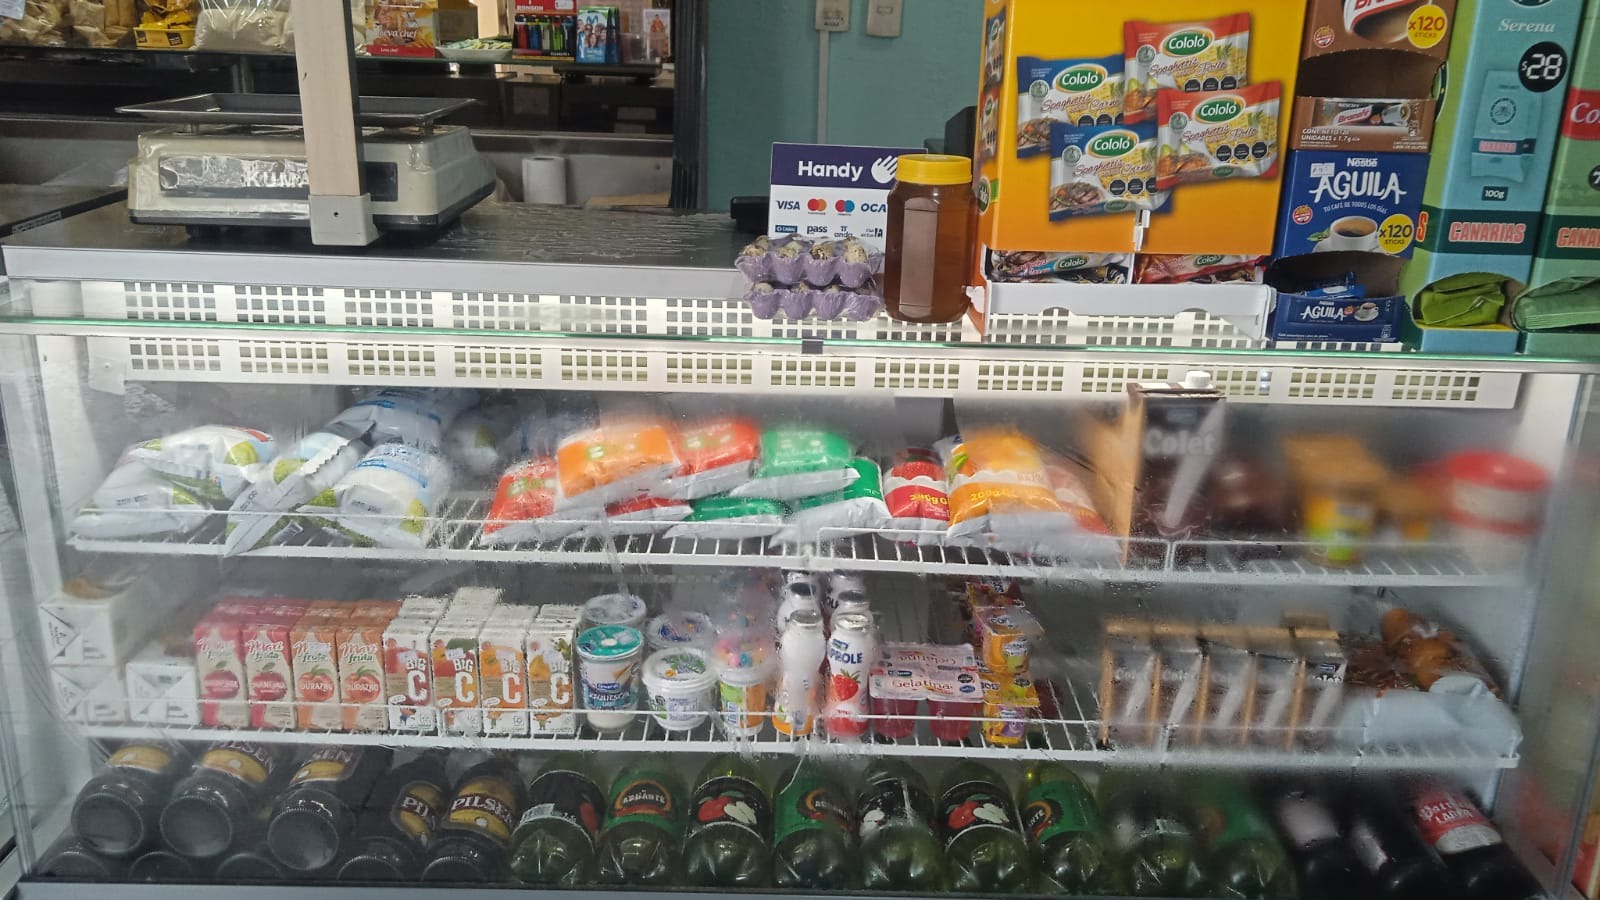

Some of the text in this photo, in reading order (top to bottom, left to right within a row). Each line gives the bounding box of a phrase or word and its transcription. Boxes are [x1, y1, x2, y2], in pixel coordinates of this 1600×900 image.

[1408, 15, 1446, 32] x120
[1498, 18, 1556, 33] Serena
[798, 160, 863, 182] Handy
[1484, 189, 1505, 199] 100g
[776, 200, 801, 211] VISA
[860, 202, 887, 213] OCA
[1379, 224, 1413, 238] x120
[1449, 221, 1527, 243] CANARIAS
[1300, 305, 1348, 321] AGUILA
[453, 657, 474, 673] BIG
[407, 670, 427, 702] C
[455, 671, 474, 703] C
[502, 672, 521, 704] C
[550, 673, 570, 705] C
